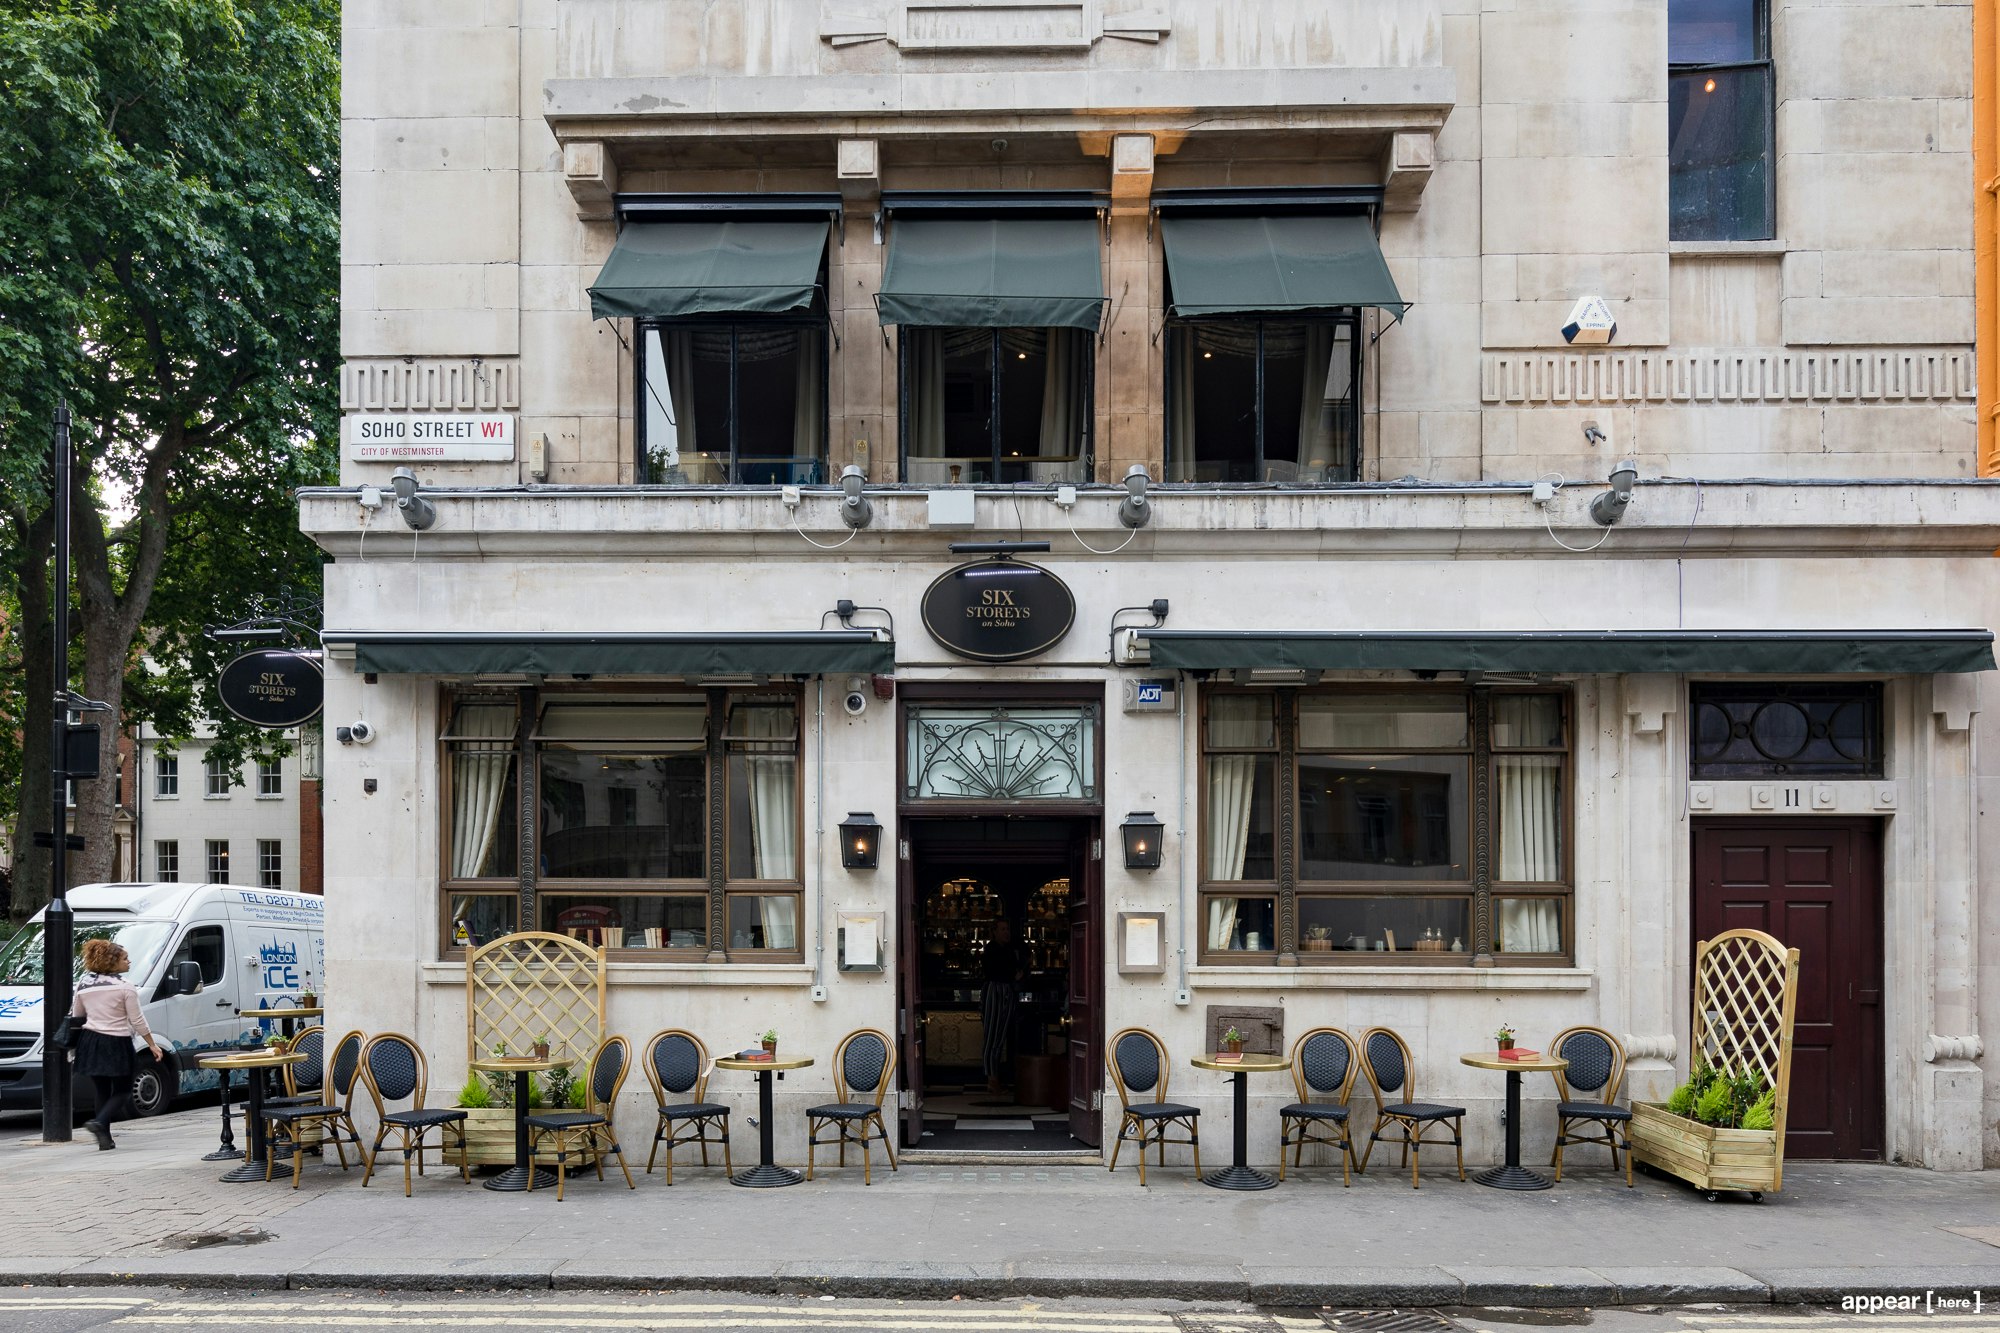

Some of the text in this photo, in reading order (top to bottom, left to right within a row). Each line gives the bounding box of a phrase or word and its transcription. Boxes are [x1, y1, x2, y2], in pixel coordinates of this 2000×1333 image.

[1596, 299, 1612, 322] SECURITY
[361, 422, 504, 438] SOHO STREET W1
[361, 447, 445, 456] CITY OF WESTMINSTER
[982, 590, 1015, 606] SIX
[966, 607, 1031, 618] STOREYS
[995, 619, 1016, 627] Soho
[260, 672, 286, 686] SIX
[248, 684, 296, 697] STOREYS
[1139, 688, 1162, 700] ADT
[1785, 788, 1800, 807] 11
[239, 892, 264, 904] TEL:
[265, 895, 294, 907] 0207
[297, 898, 319, 909] 720
[261, 954, 297, 963] LONDON
